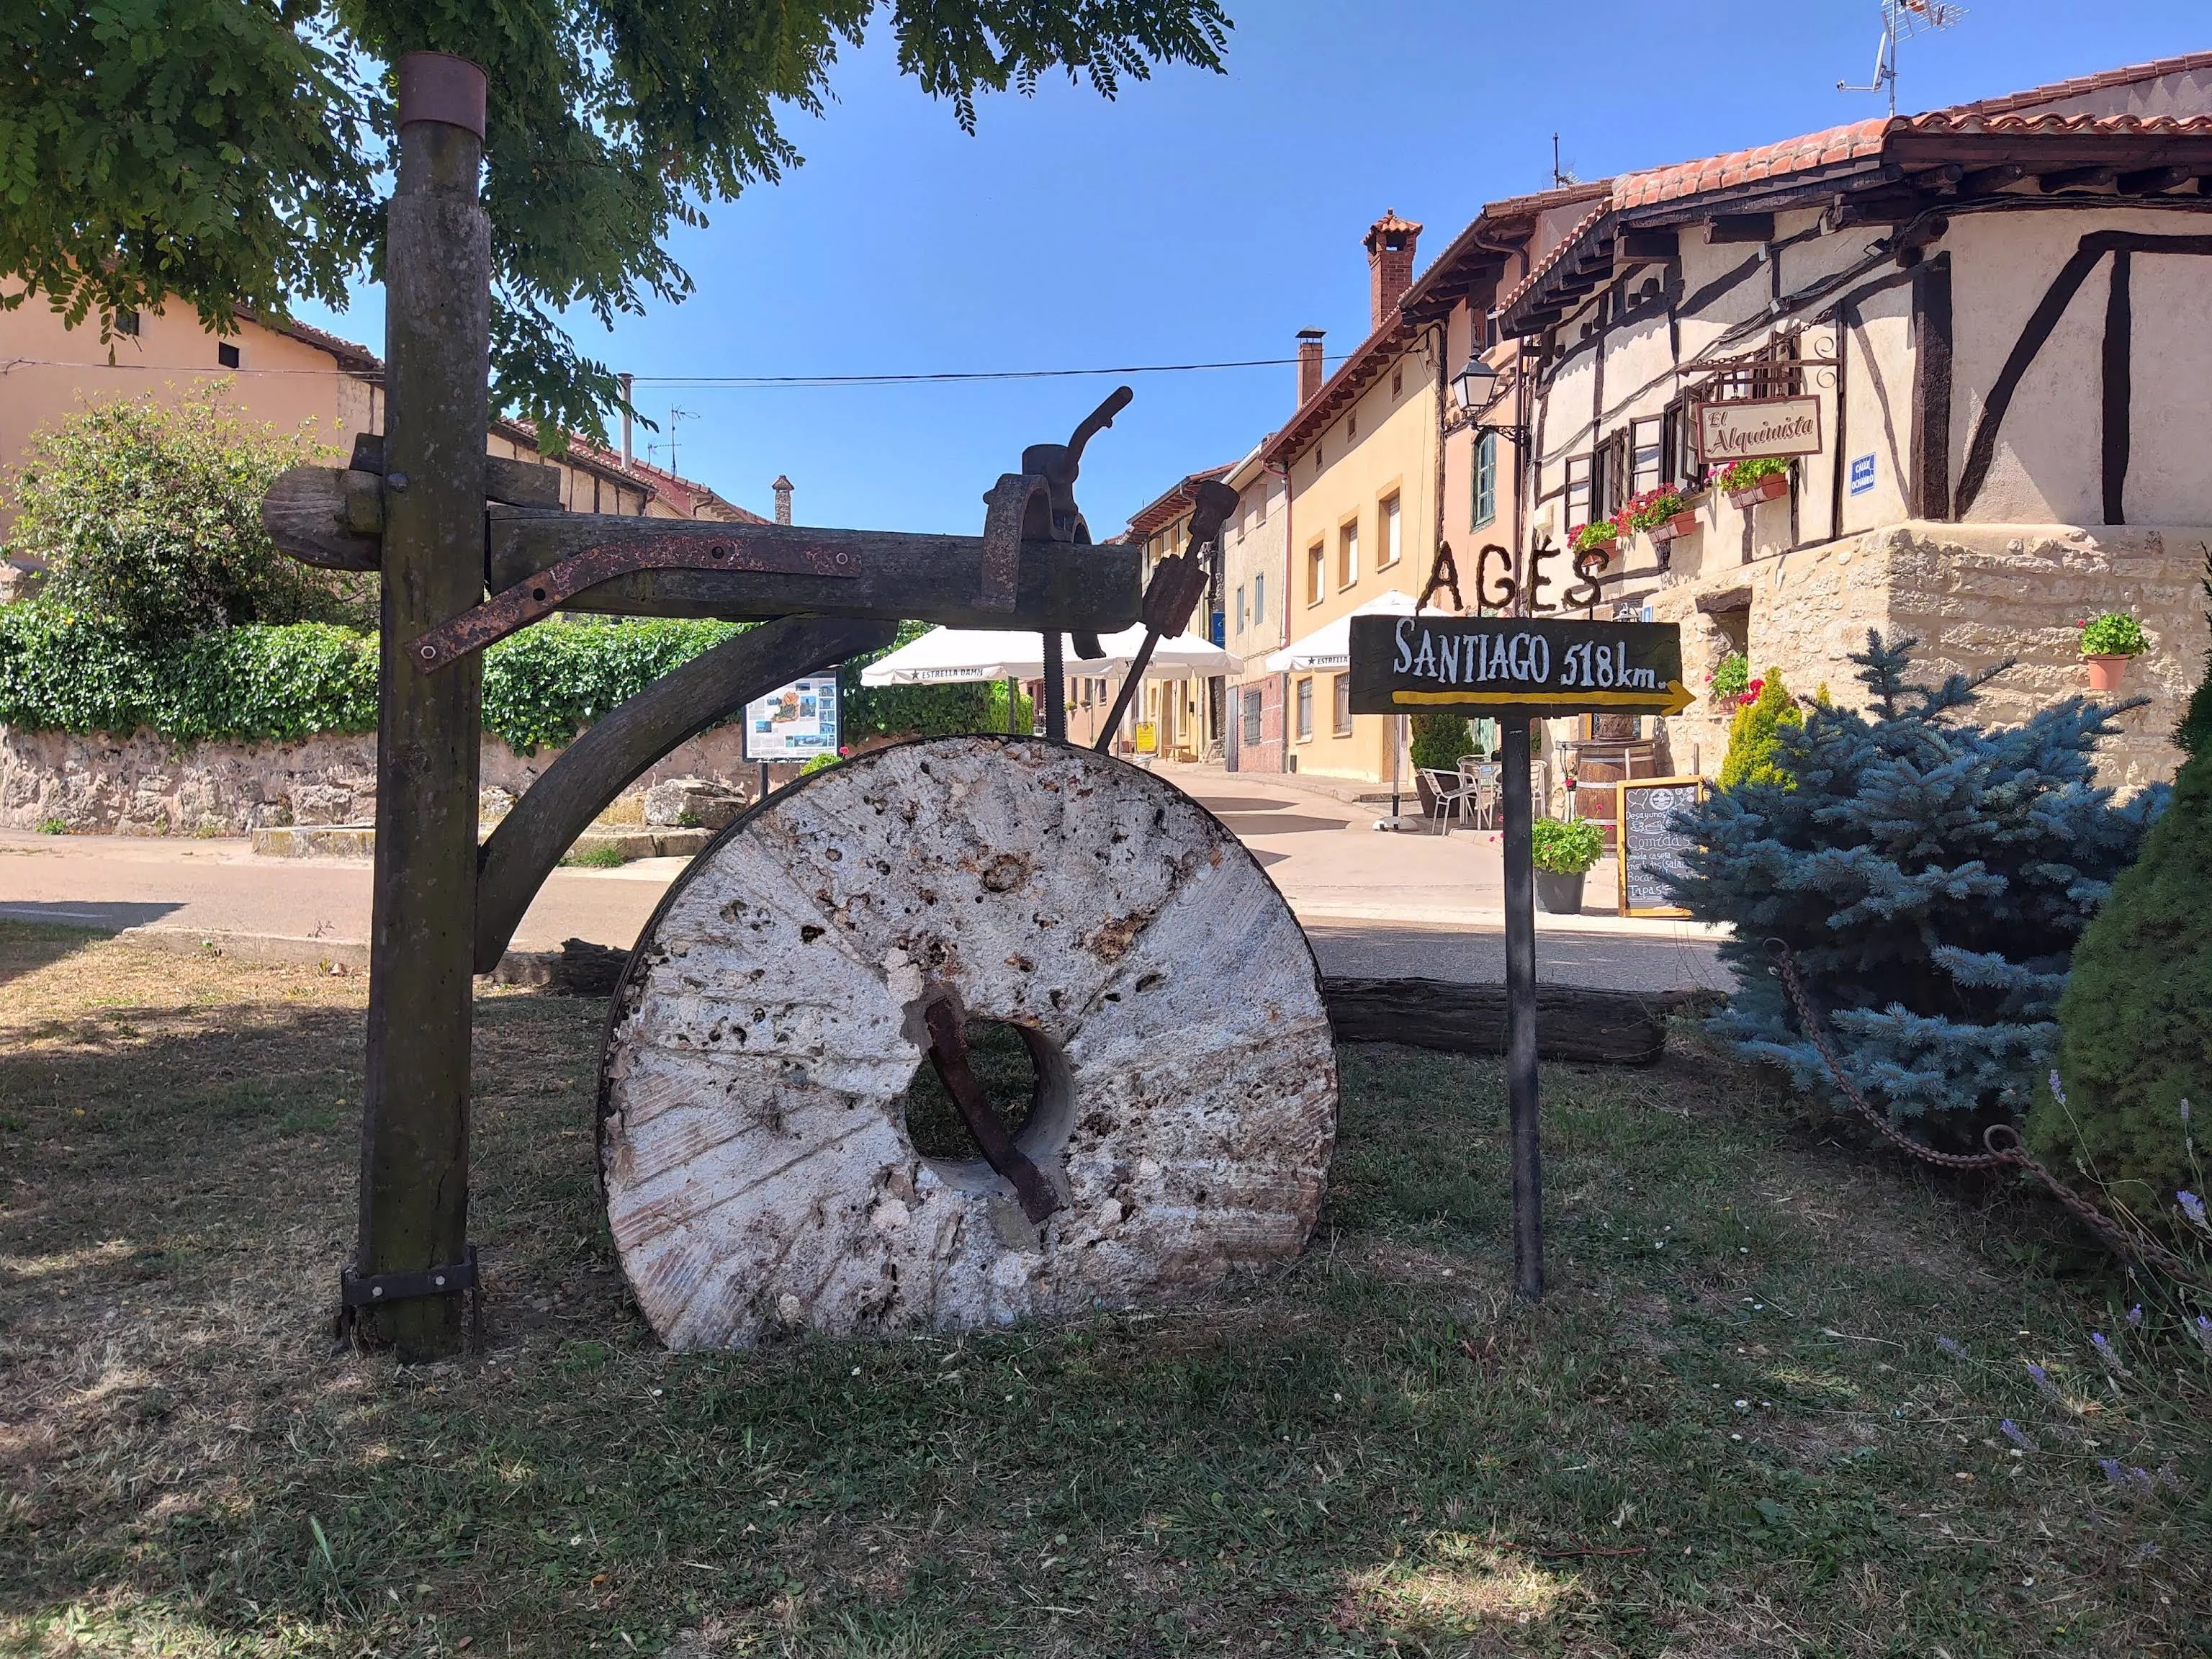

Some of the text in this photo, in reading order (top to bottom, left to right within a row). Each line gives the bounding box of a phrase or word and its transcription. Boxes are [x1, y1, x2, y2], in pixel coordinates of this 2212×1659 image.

[1708, 411, 1728, 428] El
[1707, 415, 1814, 454] Alquimista
[1855, 459, 1871, 474] CALLE
[1393, 617, 1550, 683] SANTIAGO
[1317, 656, 1349, 665] ESTRELLA
[922, 669, 958, 679] ESTRELLA
[1627, 834, 1690, 849] Comidas
[1628, 885, 1662, 899] Tapas
